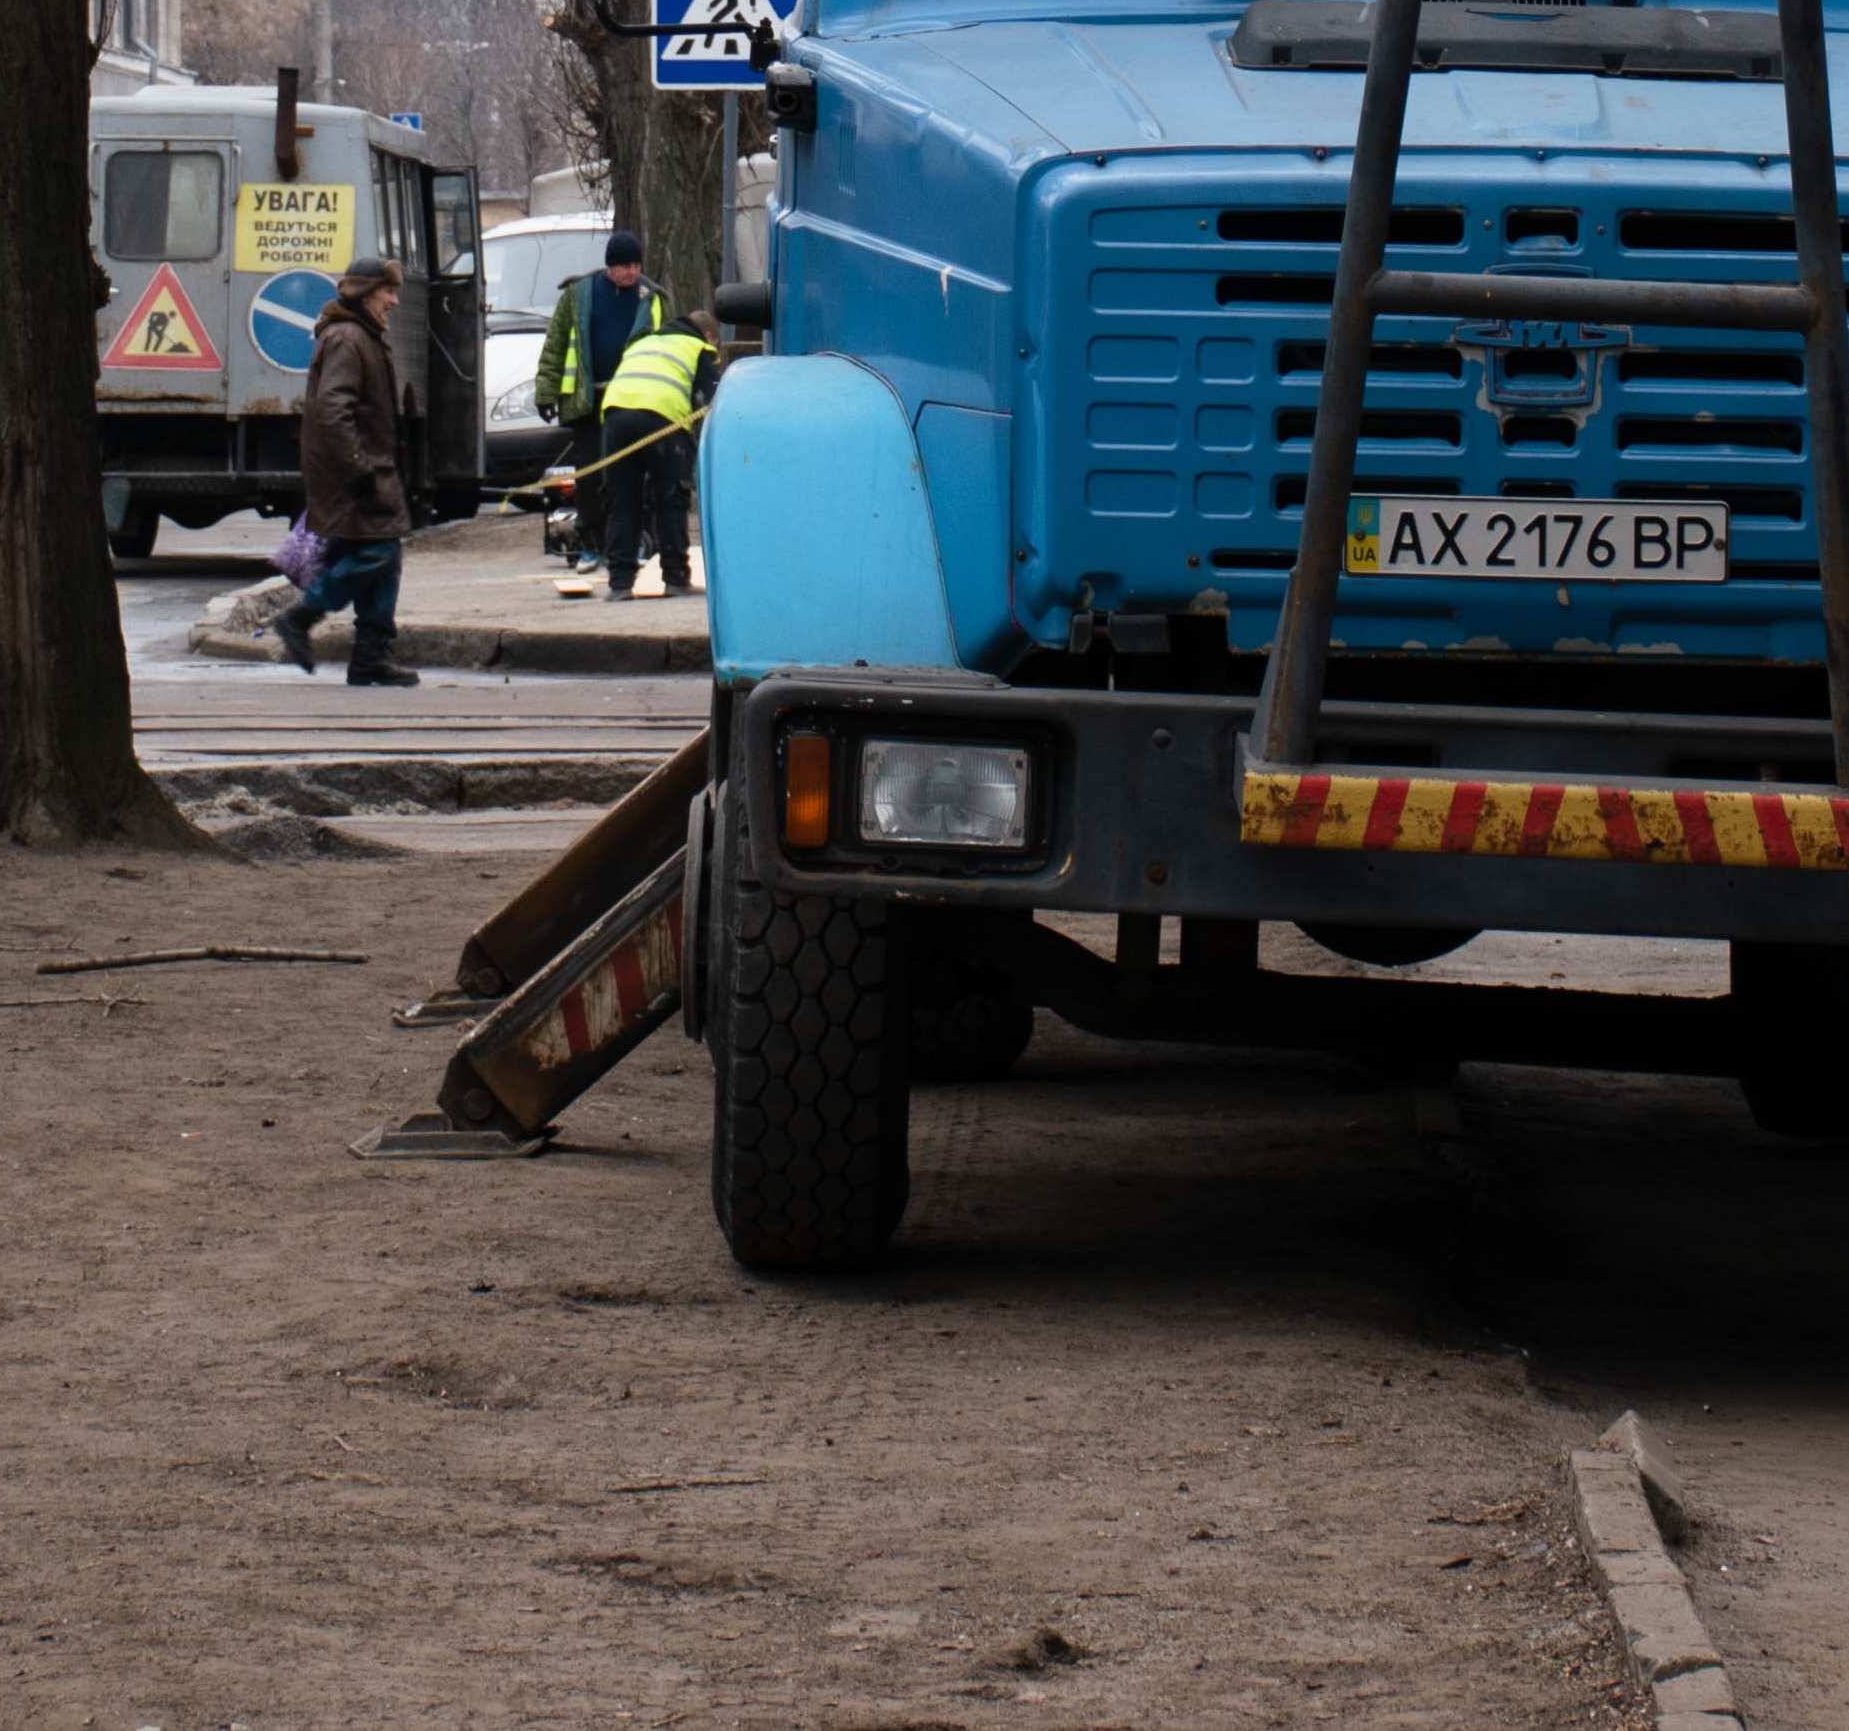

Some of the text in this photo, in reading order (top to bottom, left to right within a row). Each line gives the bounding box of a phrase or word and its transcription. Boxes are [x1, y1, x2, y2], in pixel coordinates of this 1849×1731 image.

[253, 190, 338, 213] УВАГА!
[253, 220, 337, 233] ВЕДУТЬСЯ
[256, 235, 333, 248] ДОРОЖНІ
[260, 251, 330, 263] РОБОТИ!
[1387, 510, 1715, 570] AX 2176 BP
[1352, 545, 1377, 563] UA
